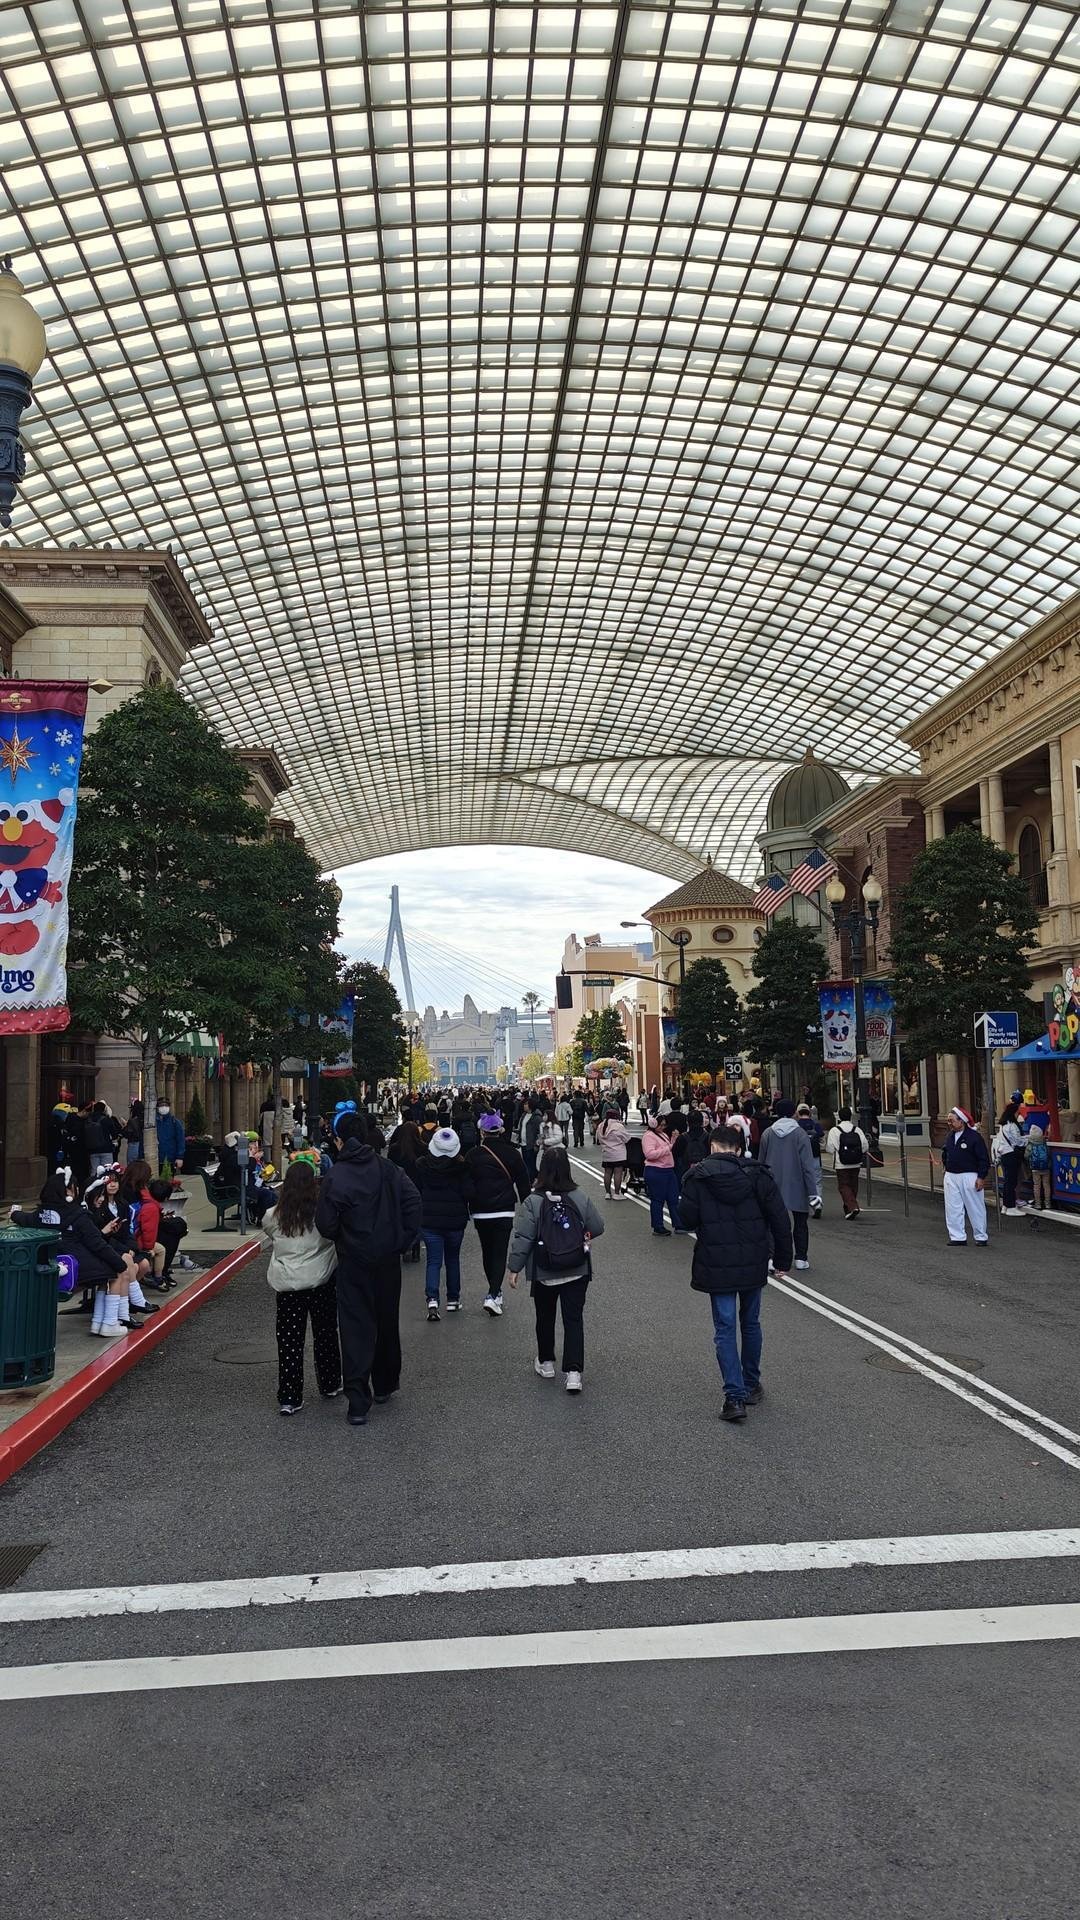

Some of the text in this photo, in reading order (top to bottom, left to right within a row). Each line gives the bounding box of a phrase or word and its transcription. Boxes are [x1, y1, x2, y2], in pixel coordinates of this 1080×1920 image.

[0, 964, 35, 993] lmo
[866, 1022, 884, 1030] FOOD
[864, 1029, 889, 1037] ESTIVAL
[988, 1037, 1018, 1046] Parking
[726, 1063, 741, 1074] 30
